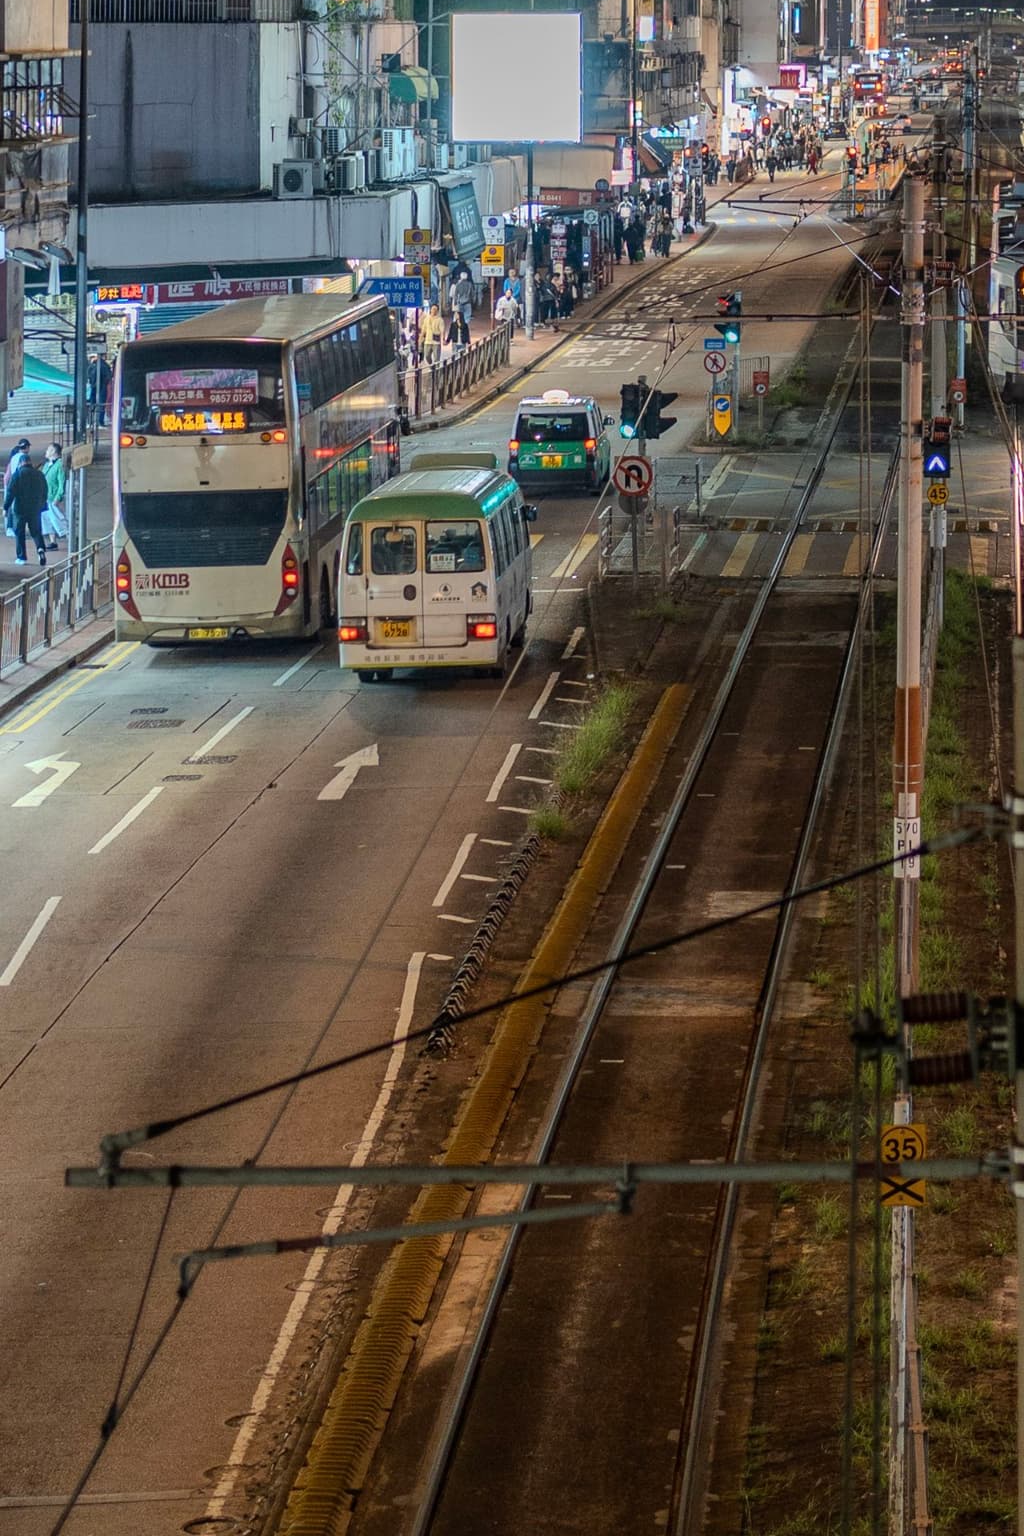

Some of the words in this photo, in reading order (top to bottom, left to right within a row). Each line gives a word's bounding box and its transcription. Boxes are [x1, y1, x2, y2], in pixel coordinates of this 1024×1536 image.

[380, 282, 391, 290] Tai
[394, 282, 407, 290] Yuk
[409, 282, 420, 290] Rd
[929, 487, 947, 500] 45
[152, 573, 190, 589] KMB
[885, 1138, 917, 1162] 35
